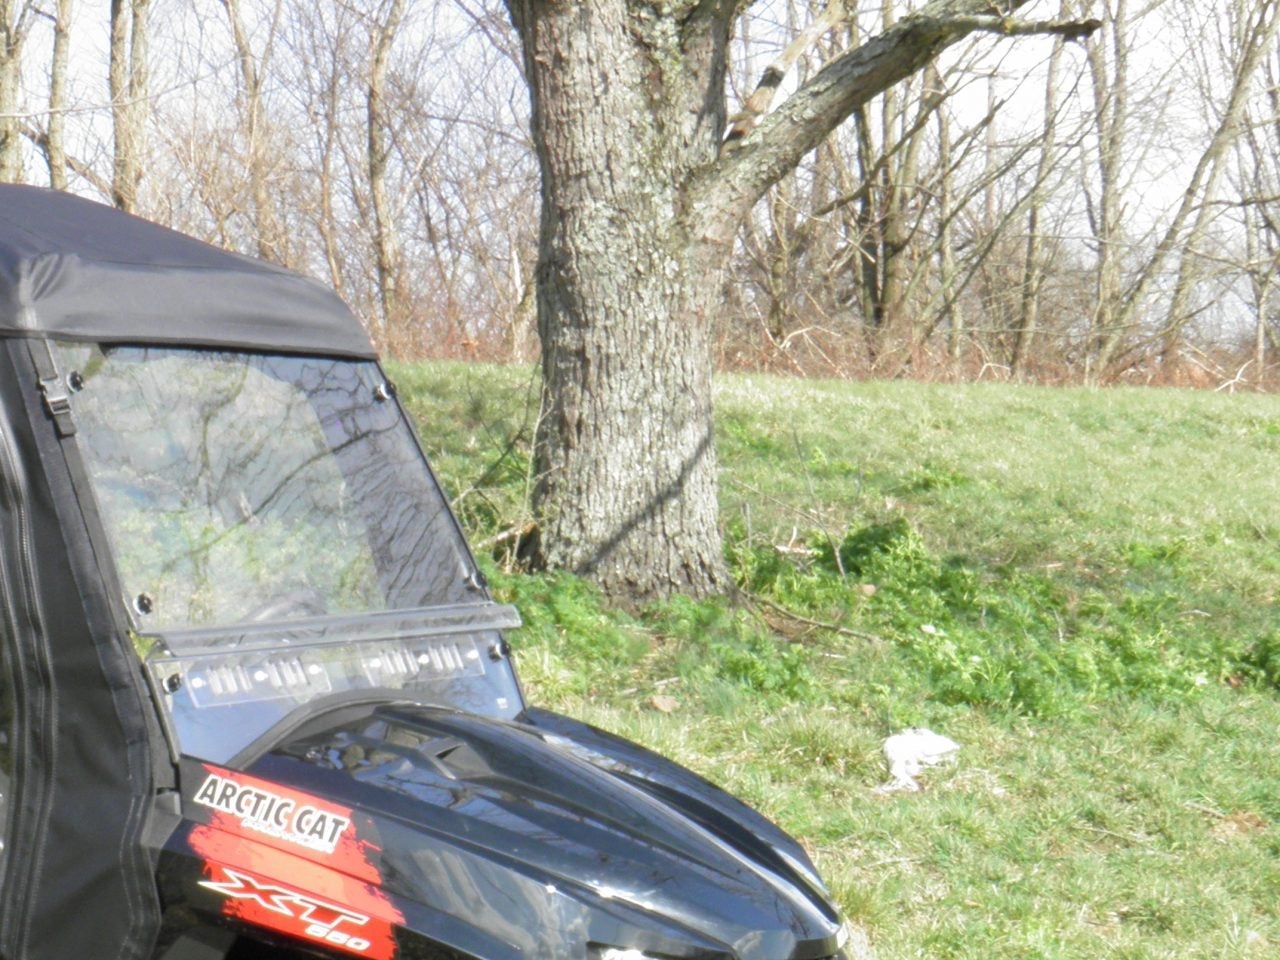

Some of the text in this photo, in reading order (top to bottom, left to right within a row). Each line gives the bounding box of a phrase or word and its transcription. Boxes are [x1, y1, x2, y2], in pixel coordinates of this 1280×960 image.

[195, 775, 293, 828] ARCTIC
[294, 805, 349, 845] CAT
[197, 868, 371, 928] XT
